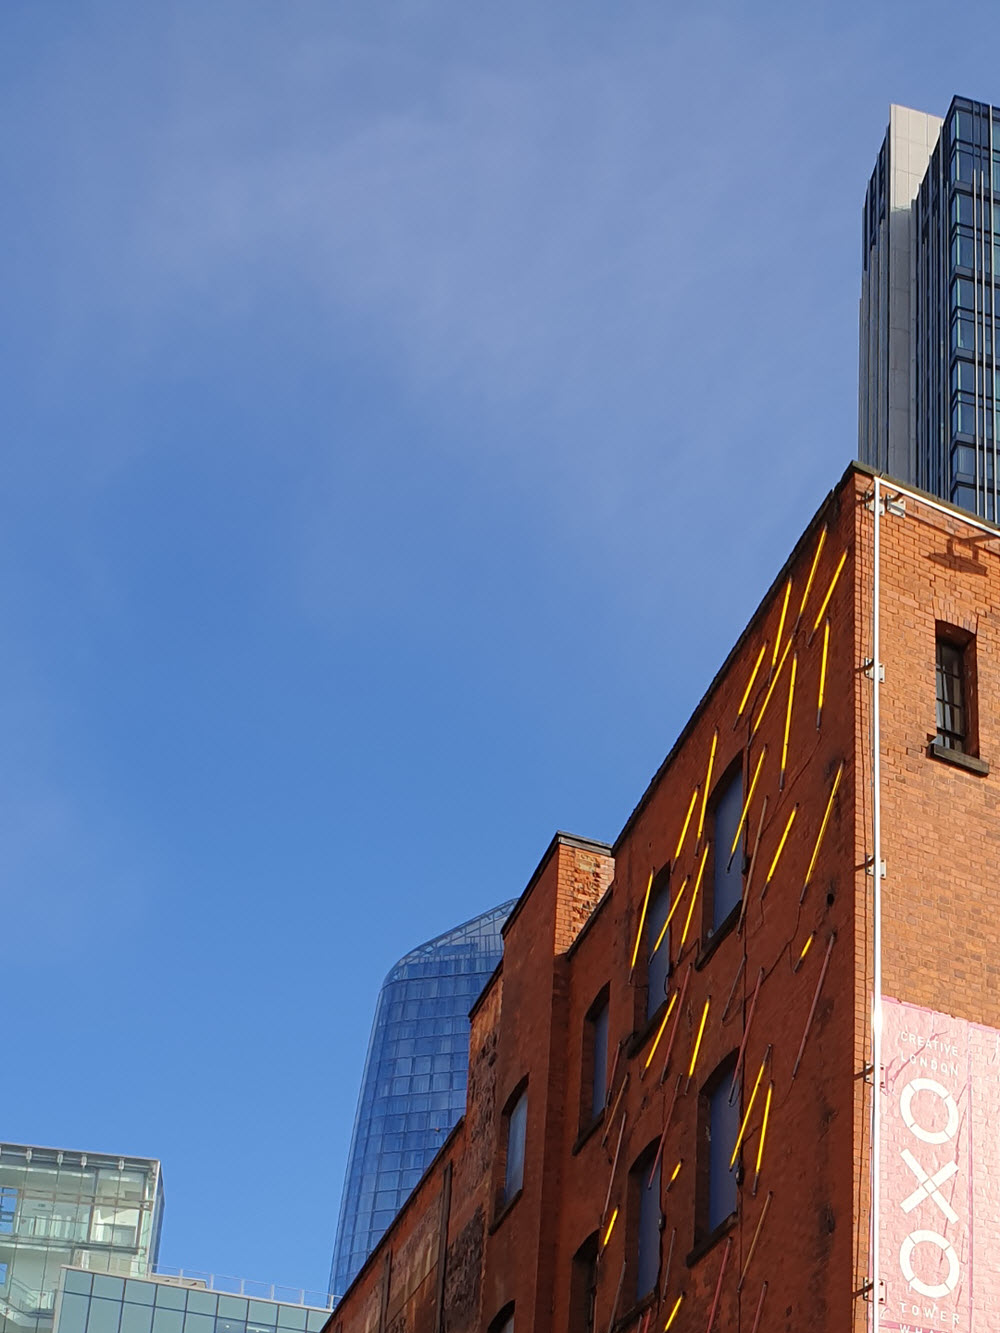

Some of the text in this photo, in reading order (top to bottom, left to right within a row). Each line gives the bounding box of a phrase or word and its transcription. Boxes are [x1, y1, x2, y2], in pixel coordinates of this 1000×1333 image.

[900, 1031, 958, 1057] CREATIVE
[900, 1051, 958, 1077] LONDON
[899, 1077, 960, 1299] OXO
[899, 1302, 960, 1325] TOWER
